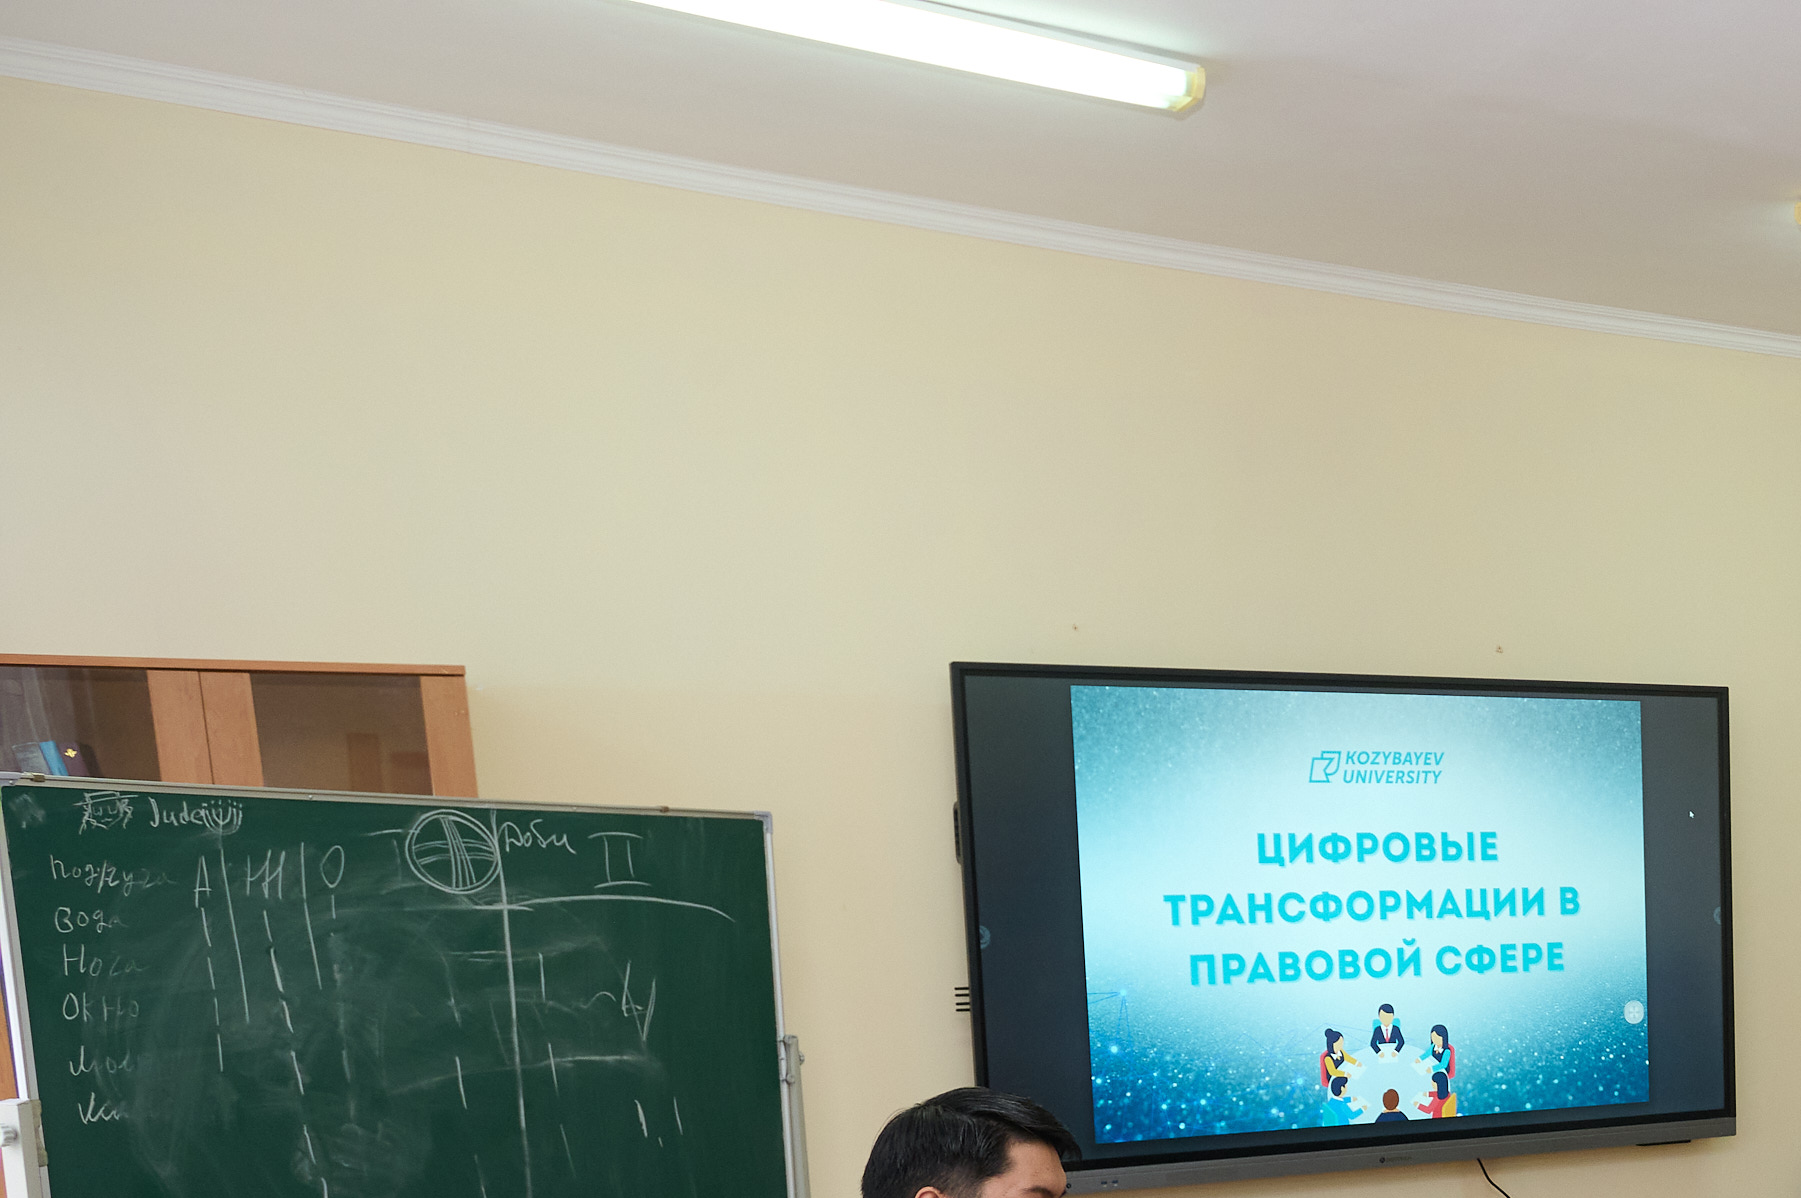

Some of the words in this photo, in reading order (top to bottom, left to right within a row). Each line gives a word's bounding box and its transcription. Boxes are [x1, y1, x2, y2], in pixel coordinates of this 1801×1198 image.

[1345, 751, 1445, 766] KOZYBAYEV
[1343, 770, 1442, 784] UNIVERSITY
[1257, 831, 1499, 867] ЦИФРОВЫЕ
[1163, 887, 1545, 926] ТРАНСФОРМАЦИИ
[1560, 886, 1581, 916] В
[1189, 938, 1422, 986] ПРАВОВОЙ
[1435, 942, 1565, 975] СФЕРЕ
